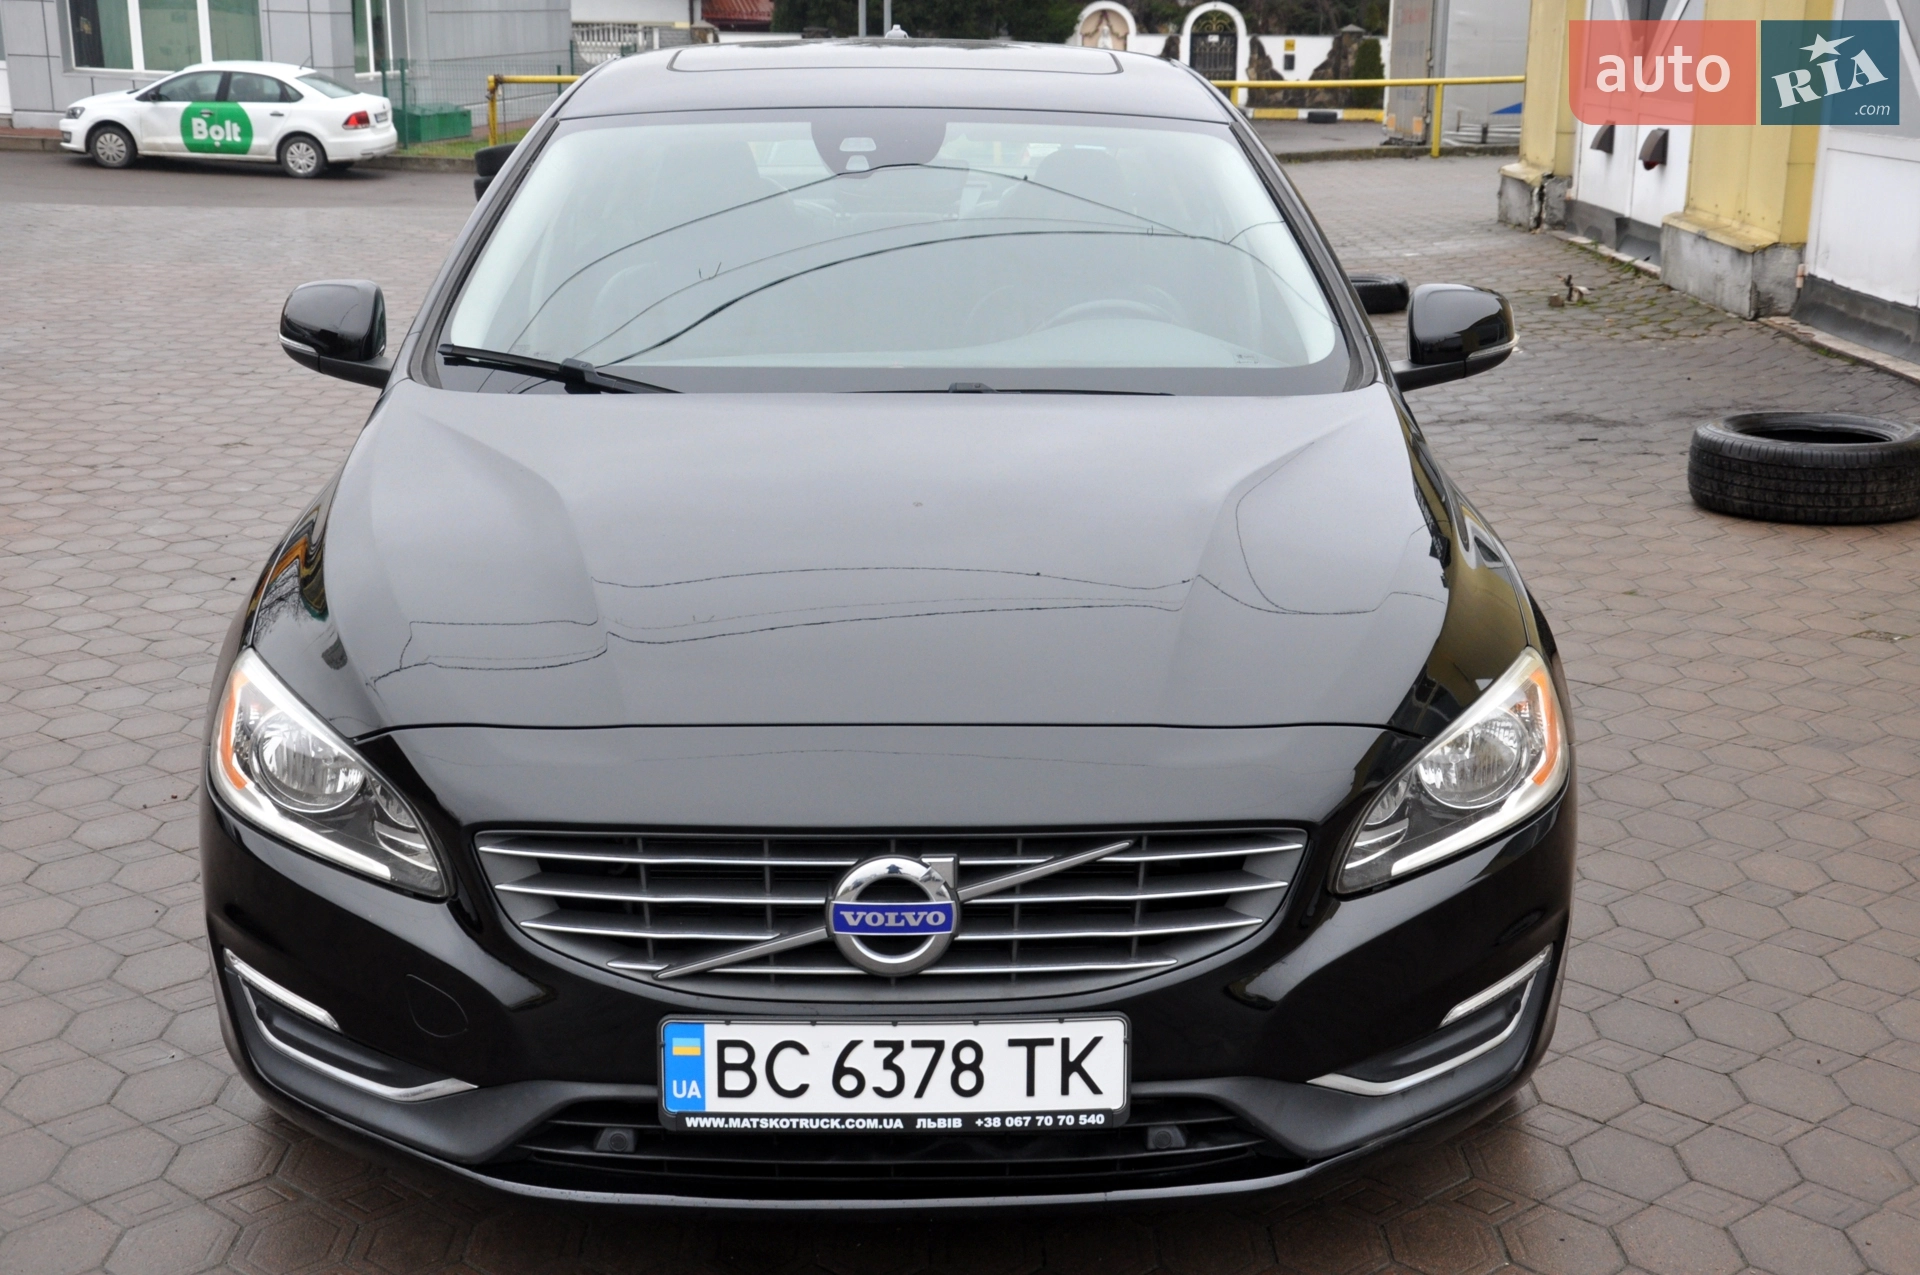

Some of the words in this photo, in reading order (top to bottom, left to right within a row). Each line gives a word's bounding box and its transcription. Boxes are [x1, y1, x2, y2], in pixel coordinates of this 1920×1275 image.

[191, 117, 242, 147] Bolt
[840, 911, 946, 926] VOLVO
[716, 1040, 810, 1099] BC
[832, 1040, 984, 1099] 6378
[1008, 1036, 1103, 1097] TK
[672, 1080, 701, 1099] UA
[686, 1117, 903, 1129] WWW.MATSKOTRUCK.COM.UA
[916, 1118, 962, 1128] ЛЬВІВ
[975, 1117, 1001, 1127] +38
[1005, 1116, 1031, 1127] 067
[1036, 1116, 1053, 1126] 70
[1057, 1115, 1074, 1125] 70
[1079, 1114, 1105, 1125] 540
